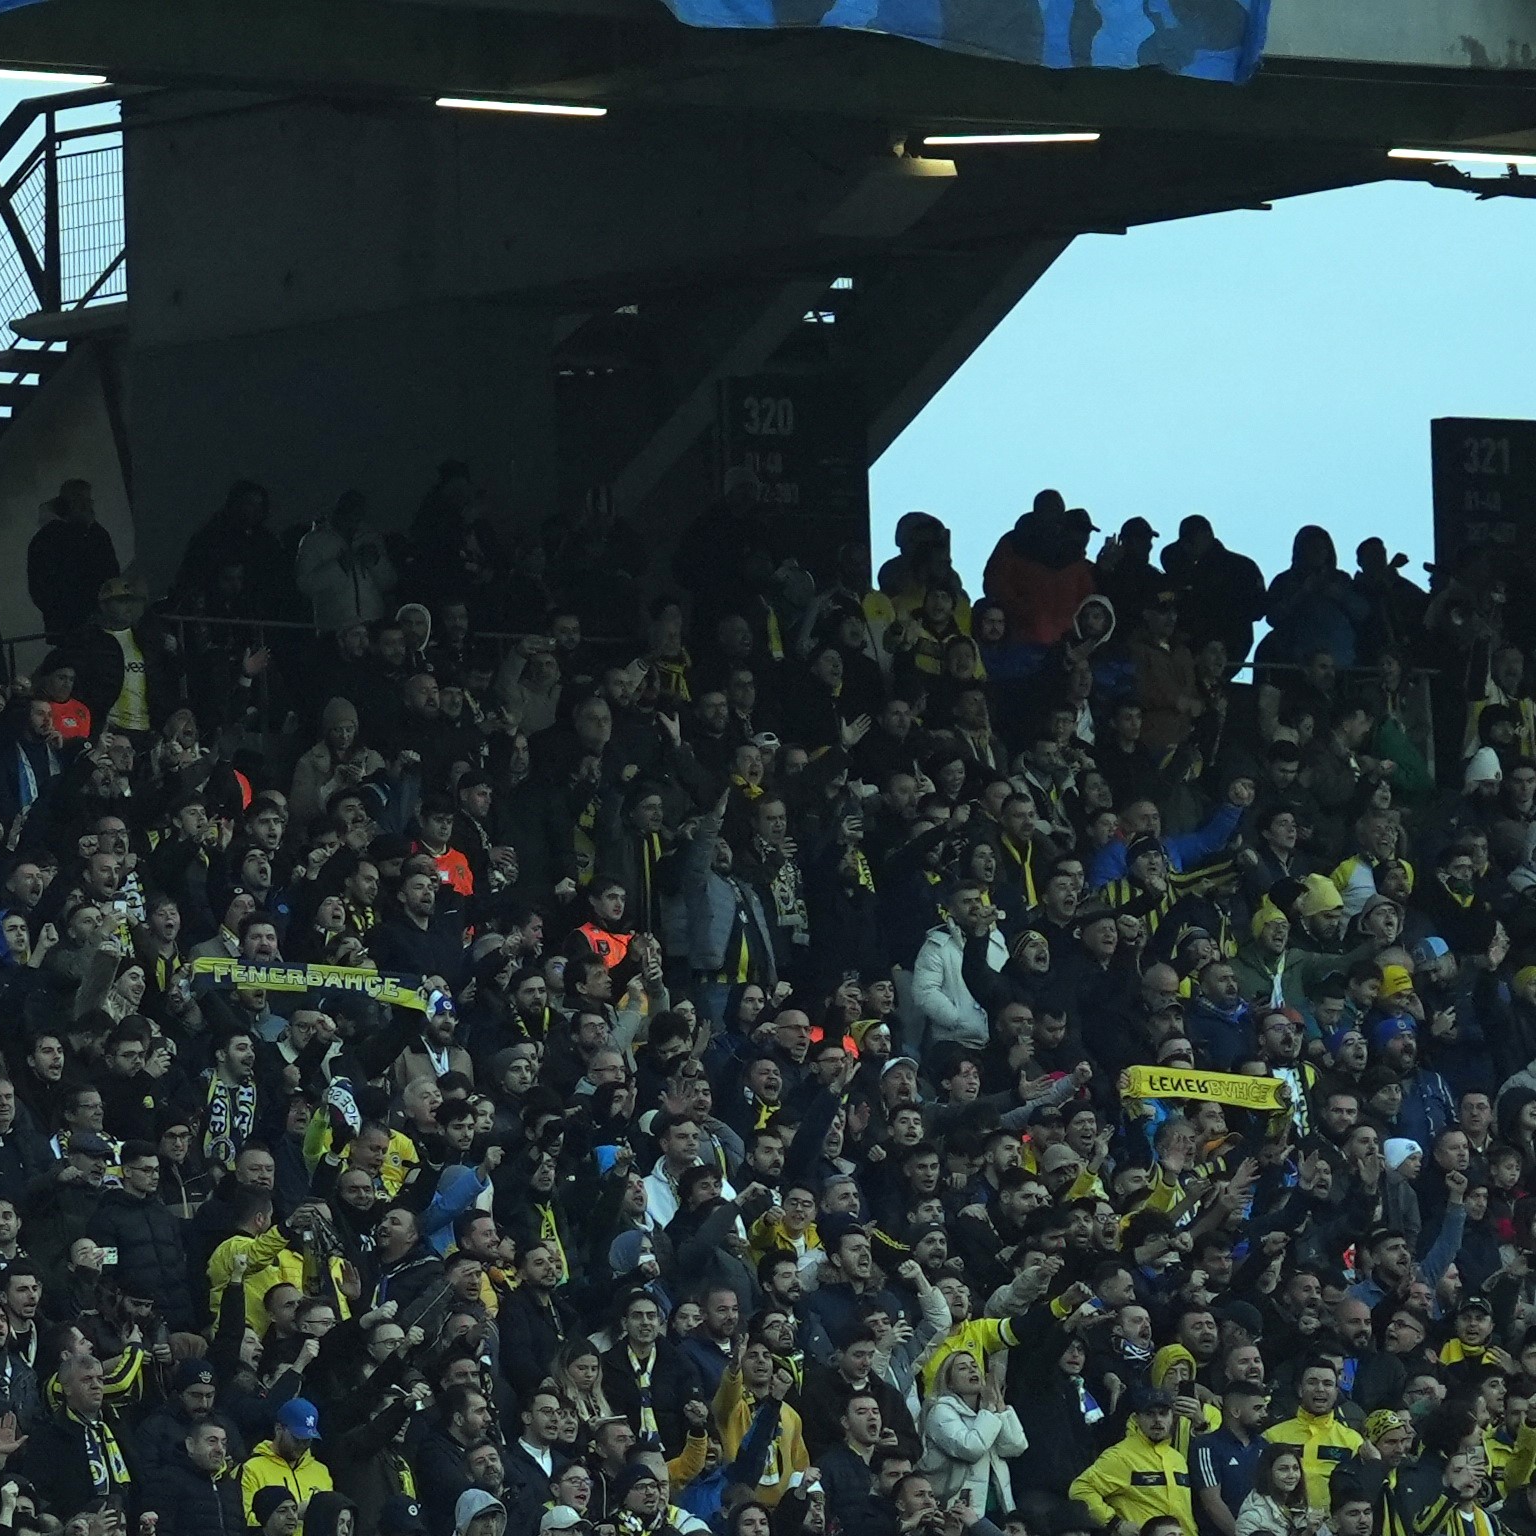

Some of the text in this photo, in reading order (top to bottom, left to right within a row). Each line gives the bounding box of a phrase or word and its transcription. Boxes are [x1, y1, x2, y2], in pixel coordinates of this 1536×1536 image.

[743, 397, 794, 436] 320
[1463, 437, 1510, 475] 321
[212, 962, 402, 999] FENERBAHÇE
